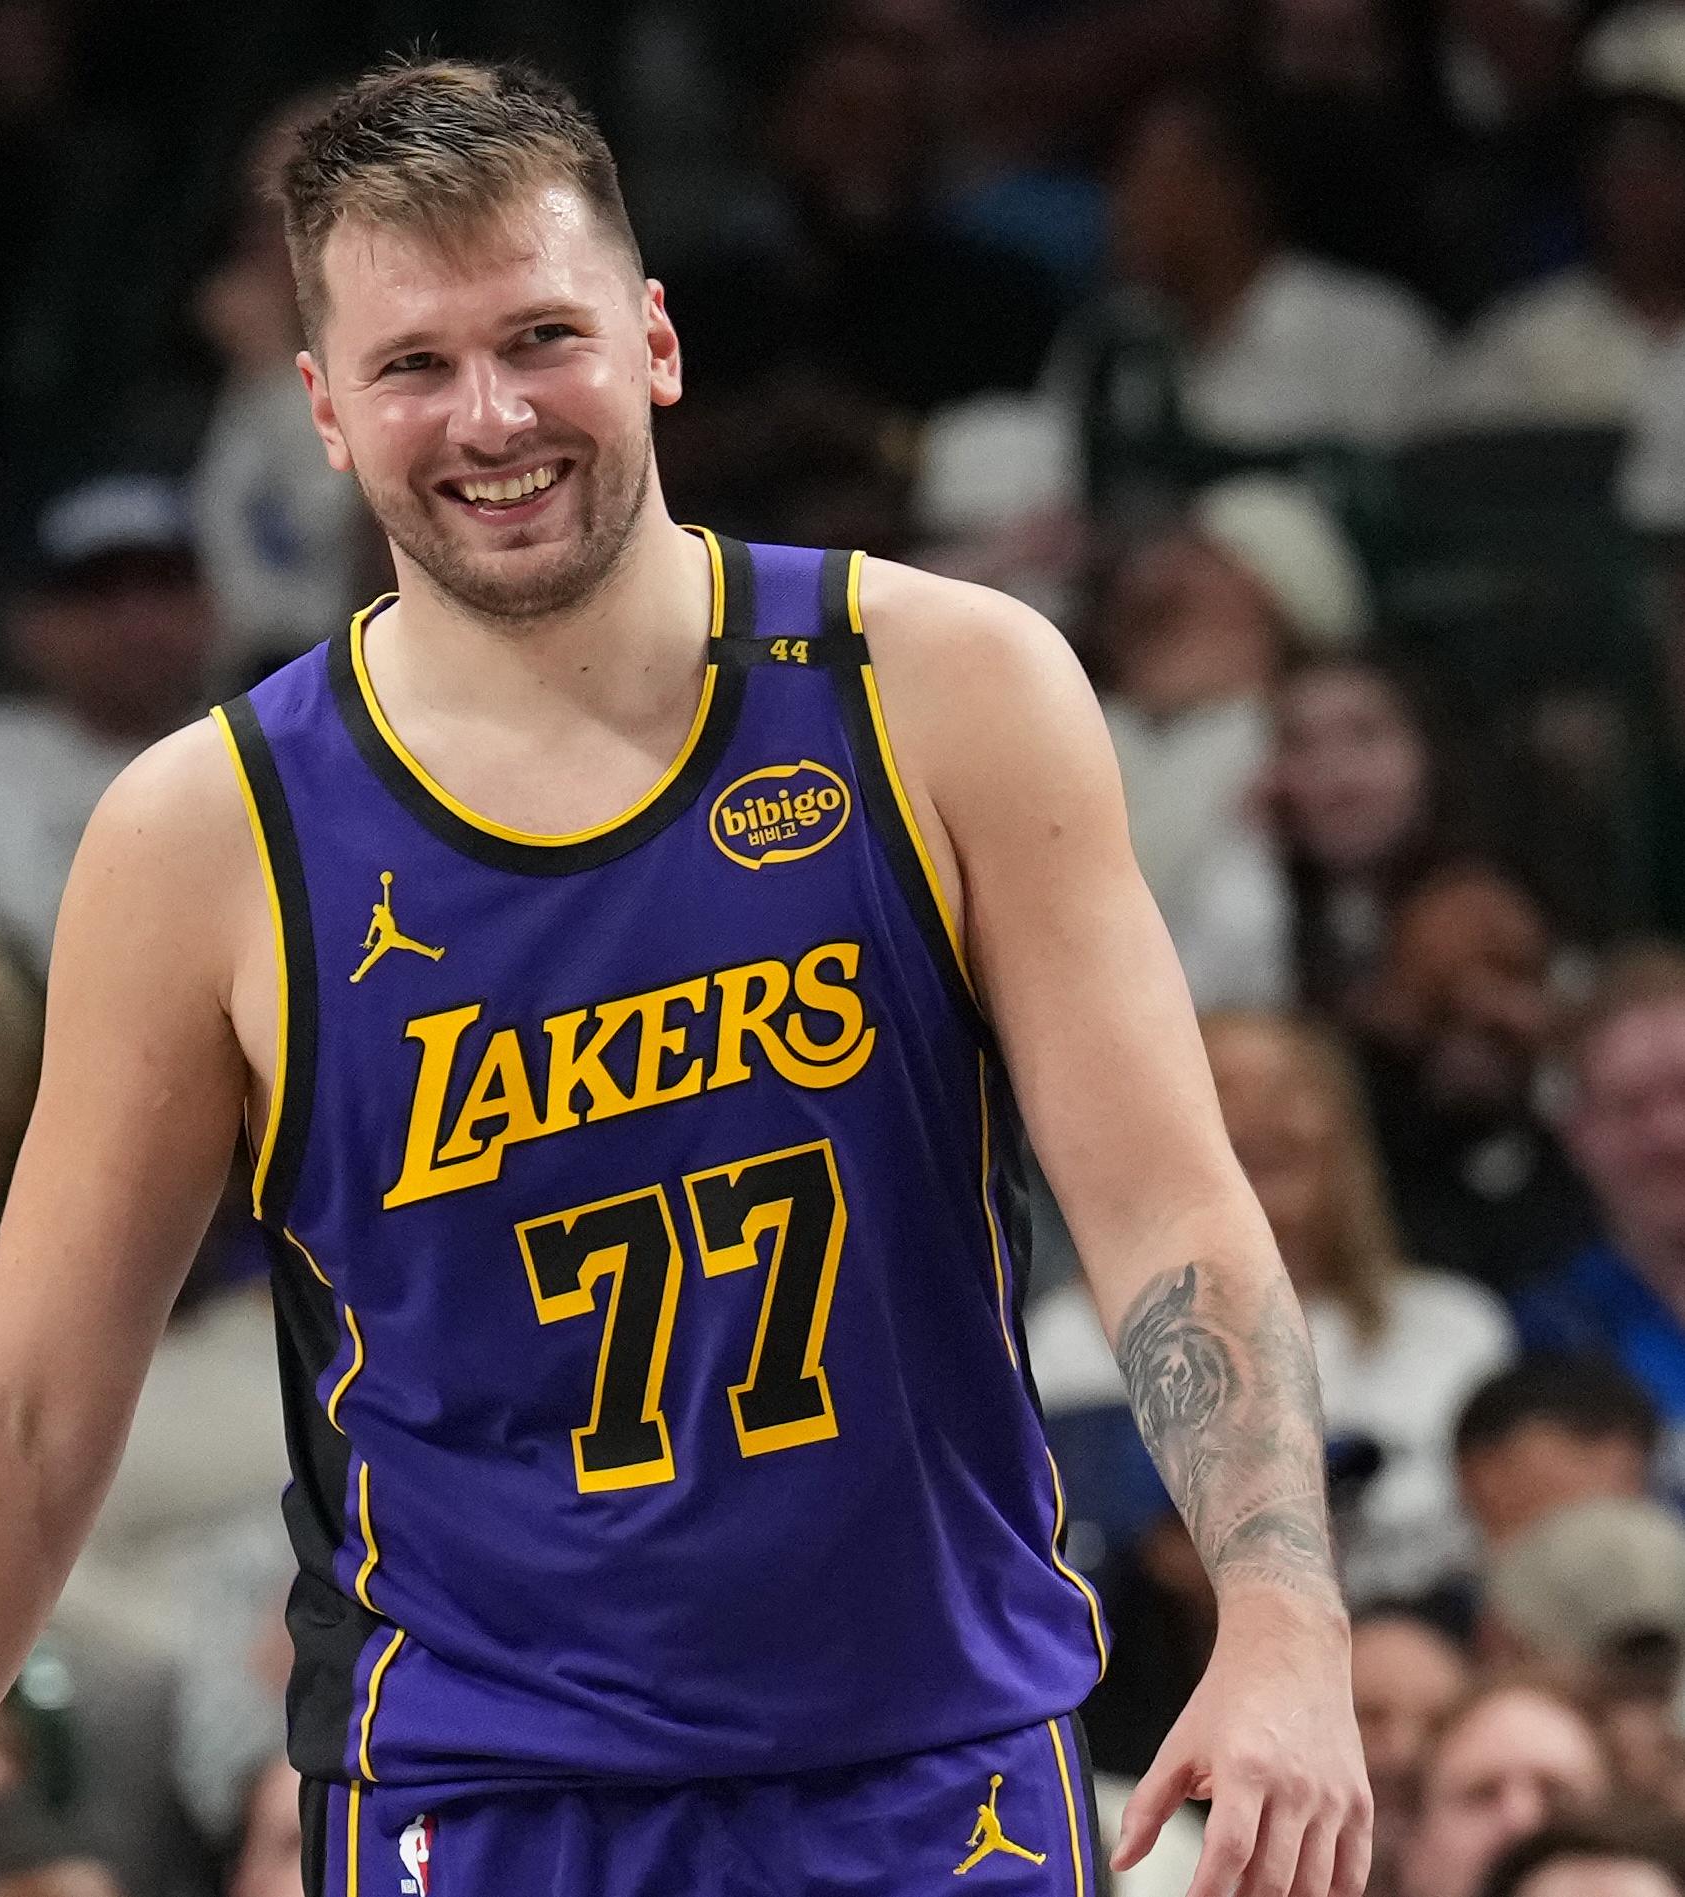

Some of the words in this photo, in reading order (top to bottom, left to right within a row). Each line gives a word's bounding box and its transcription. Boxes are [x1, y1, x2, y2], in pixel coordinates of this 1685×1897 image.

[770, 639, 808, 664] 44
[721, 787, 841, 836] bibigo
[748, 822, 798, 846] 비비고
[382, 942, 876, 1210] LAKERS
[514, 1138, 848, 1494] 77
